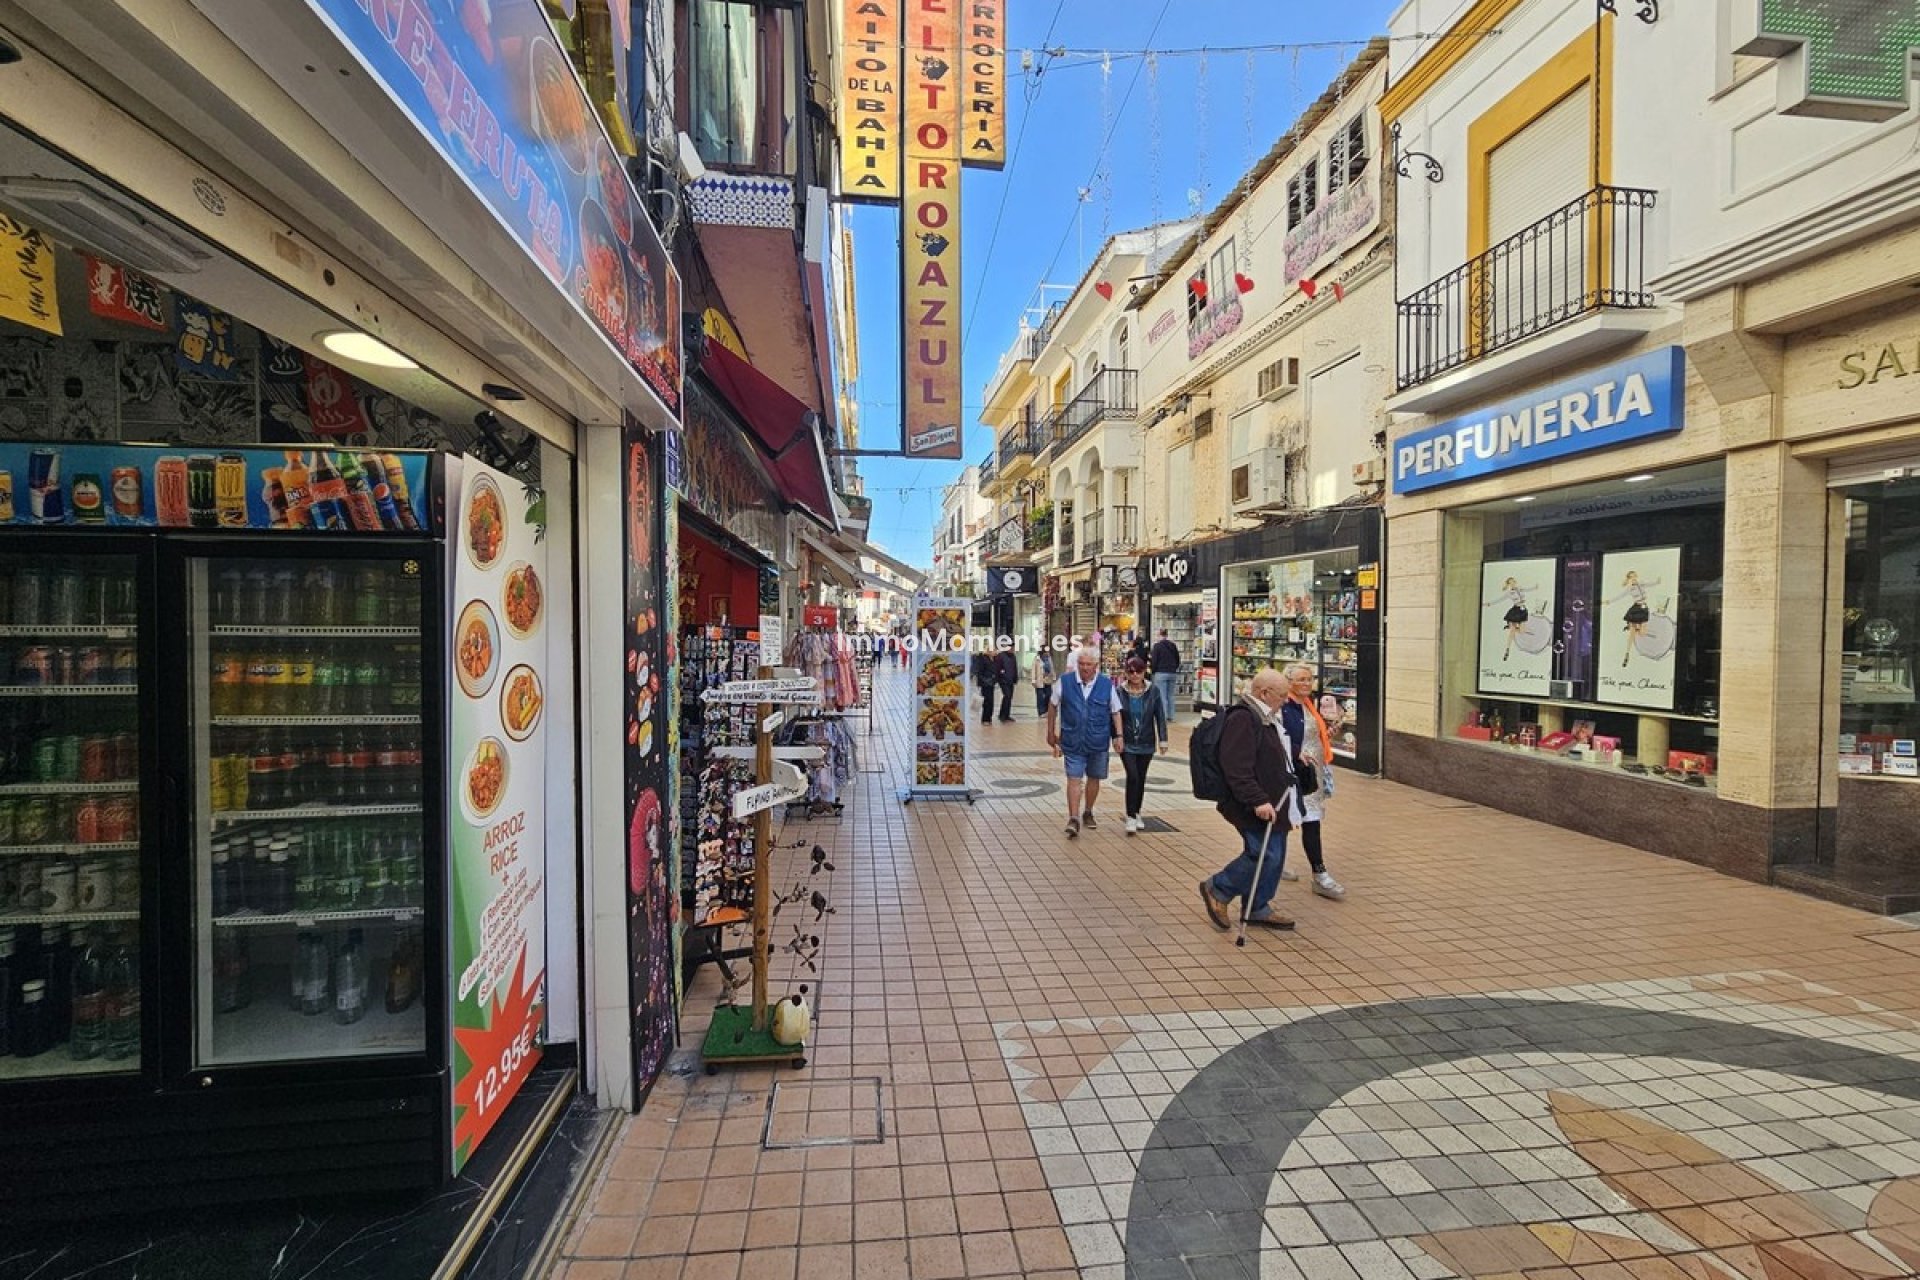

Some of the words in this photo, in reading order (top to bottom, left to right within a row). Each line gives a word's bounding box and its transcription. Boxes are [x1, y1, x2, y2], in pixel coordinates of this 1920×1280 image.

[848, 77, 868, 91] DE
[874, 80, 893, 94] LA
[971, 0, 996, 151] RROCERIA
[447, 60, 561, 257] FRUTA
[856, 98, 886, 188] BAHIA
[917, 83, 949, 228] TORO
[918, 261, 948, 403] AZUL
[1837, 341, 1920, 390] SA
[1397, 373, 1653, 480] PERFUMERIA
[482, 811, 526, 853] ARROZ
[490, 841, 518, 876] RICE
[474, 1022, 531, 1117] 12.95€
